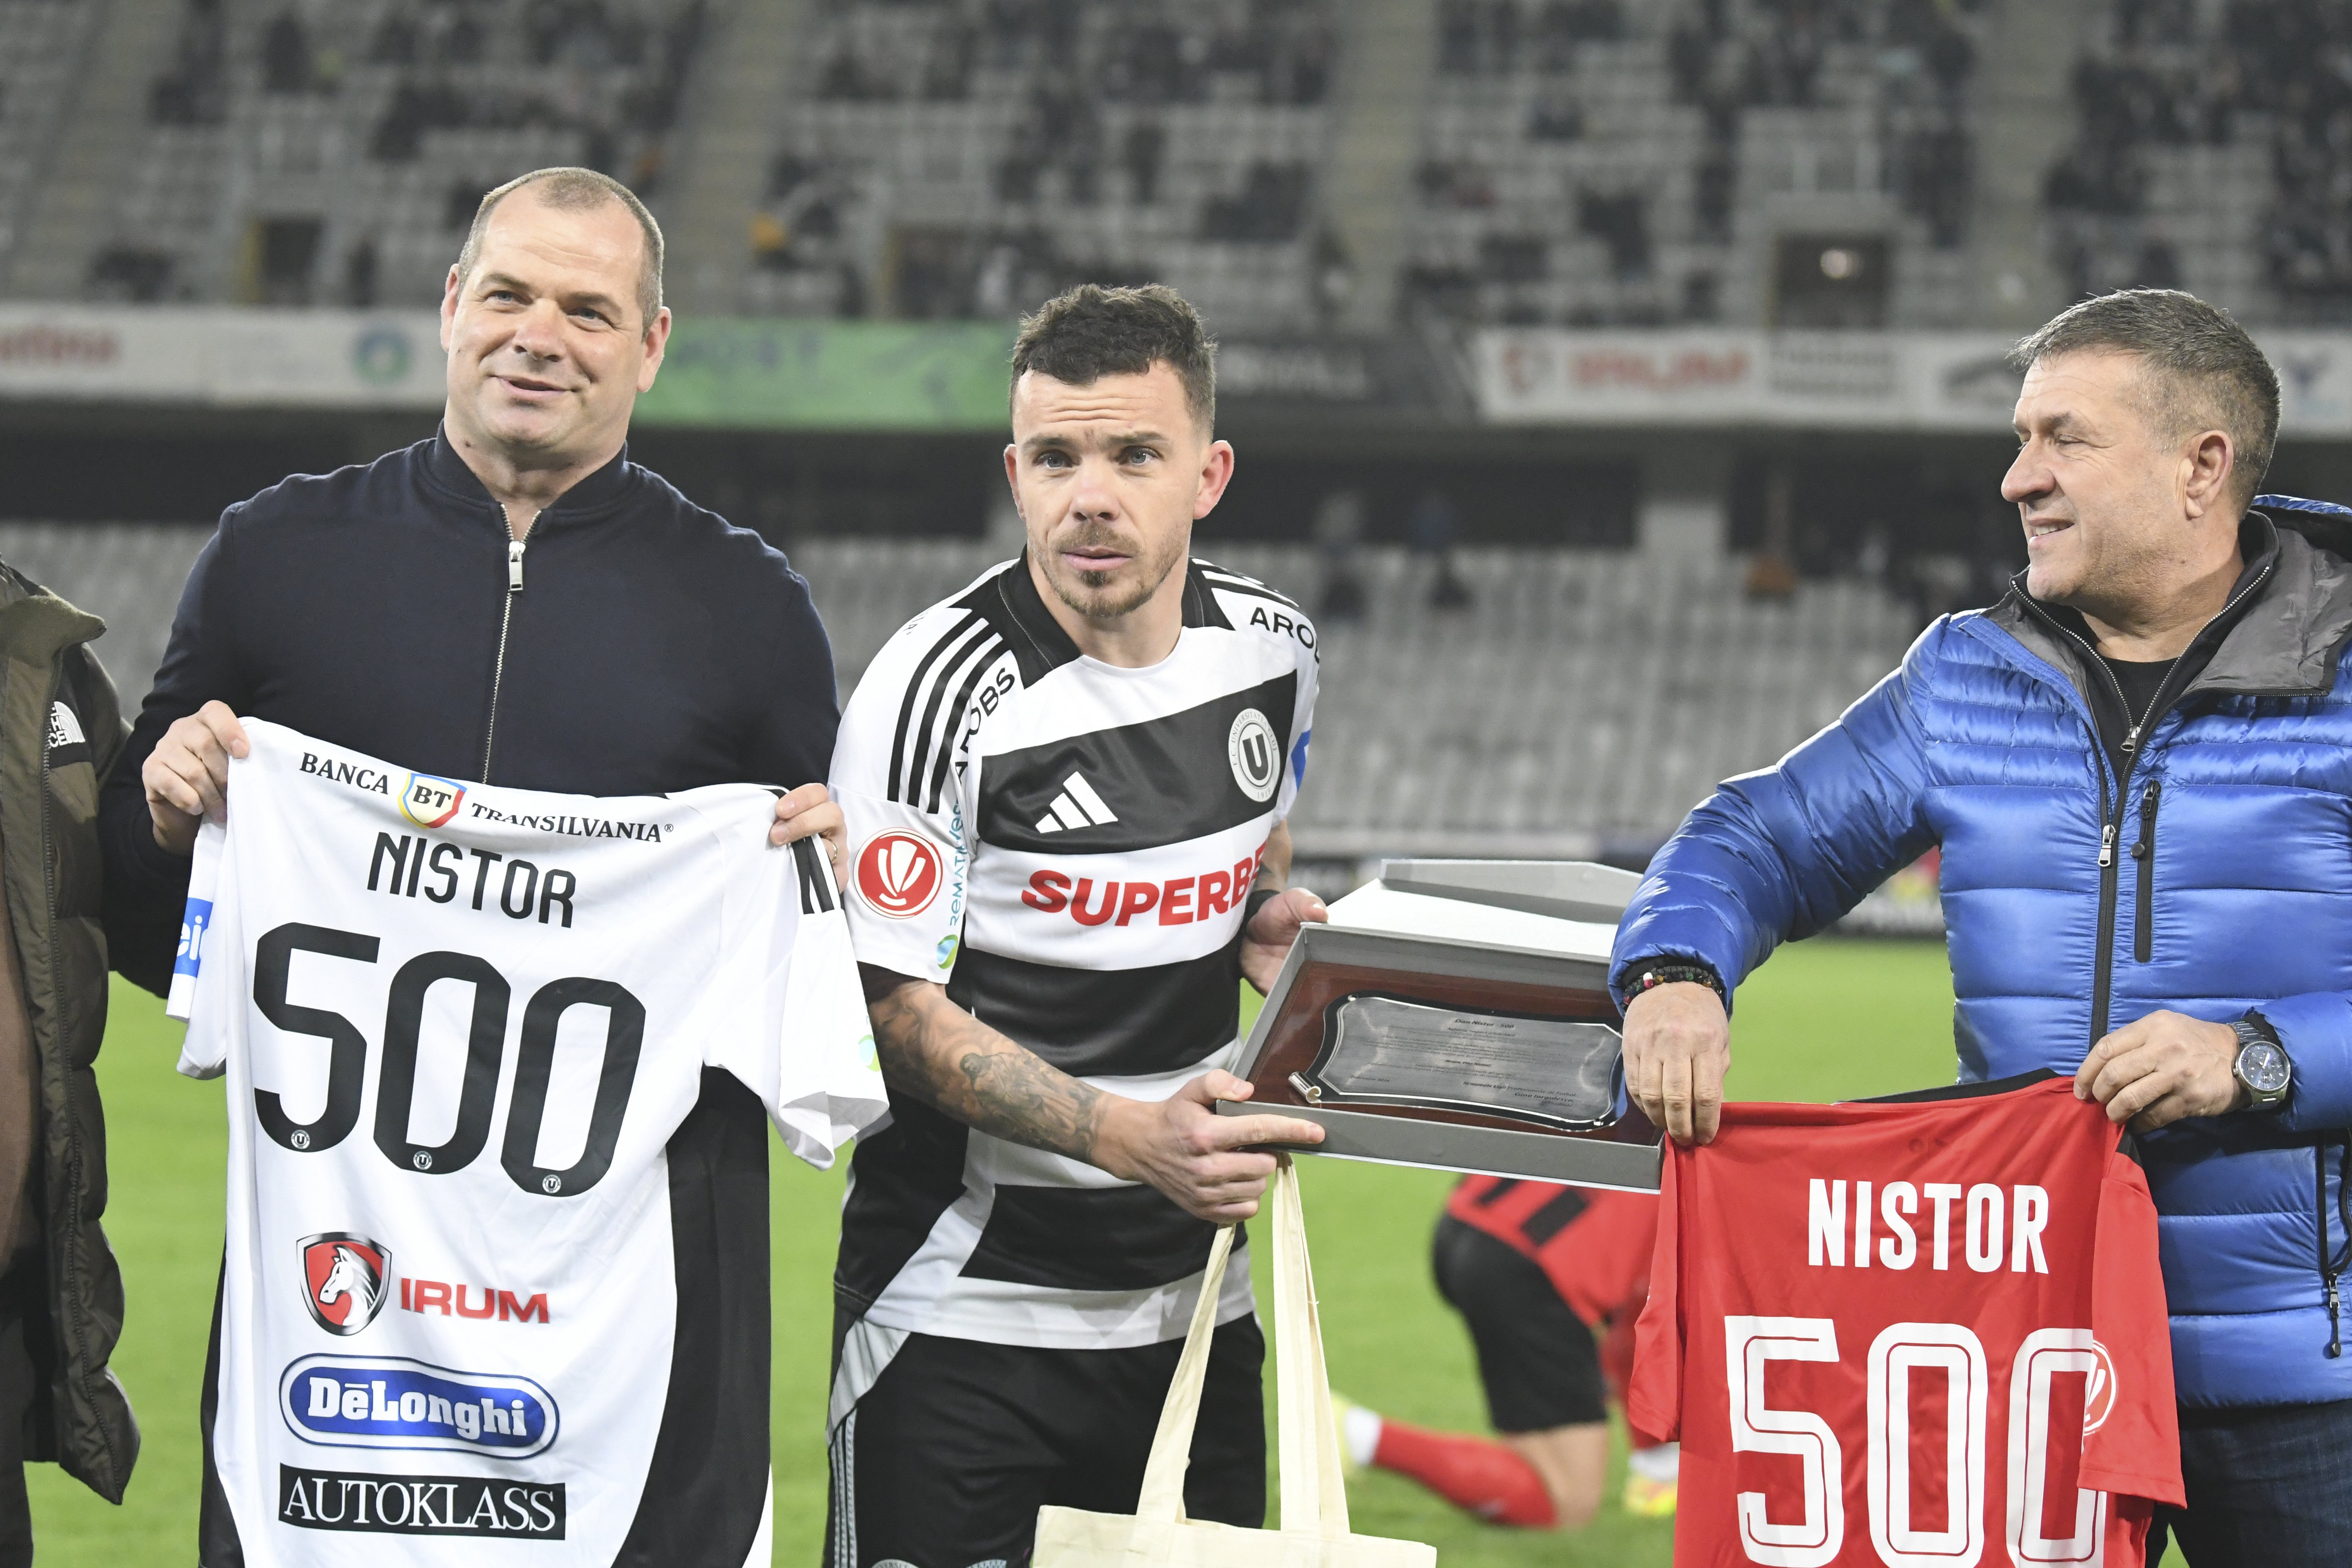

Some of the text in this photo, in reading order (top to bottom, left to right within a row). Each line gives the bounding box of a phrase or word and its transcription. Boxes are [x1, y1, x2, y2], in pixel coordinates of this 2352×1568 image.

[299, 752, 389, 795] BANCA
[412, 785, 452, 808] BT
[1242, 733, 1269, 781] U
[367, 831, 576, 928] NISTOR
[253, 922, 646, 1198] 500
[1808, 1179, 2050, 1274] NISTOR
[400, 1277, 550, 1324] IRUM
[1724, 1315, 2107, 1568] 500
[284, 1475, 555, 1532] AUTOKLASS
